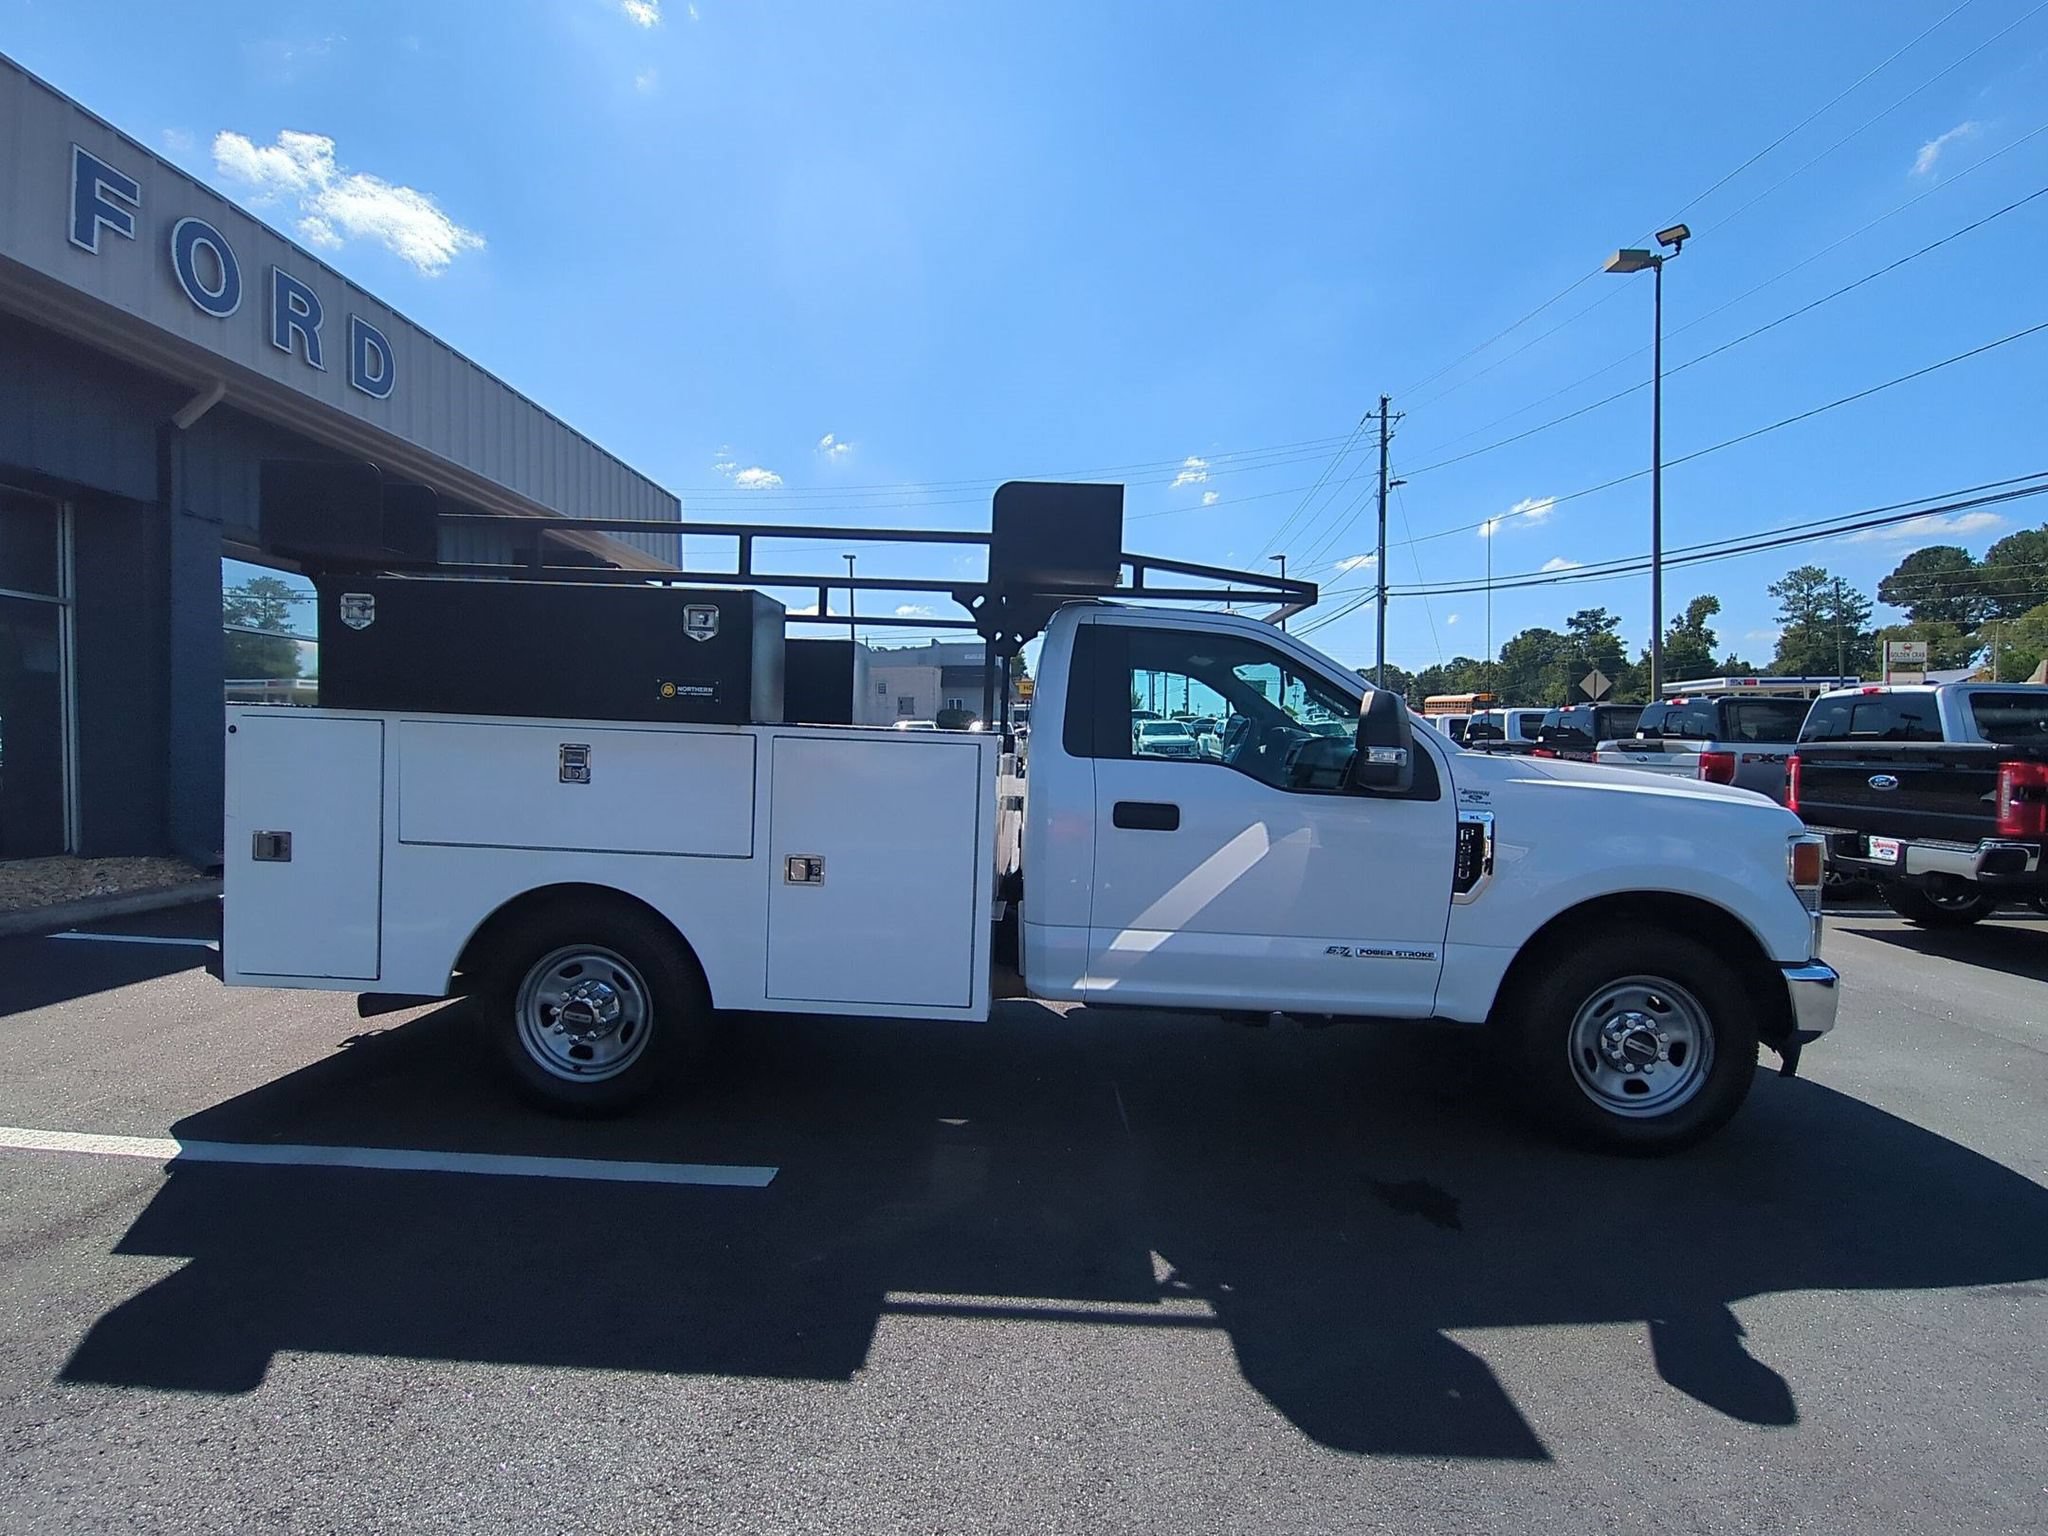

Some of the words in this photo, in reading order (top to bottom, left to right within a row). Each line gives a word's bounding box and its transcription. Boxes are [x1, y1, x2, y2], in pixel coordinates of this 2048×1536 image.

[68, 142, 397, 400] FORD
[1359, 948, 1393, 957] POWER
[1395, 950, 1435, 959] STROKE
